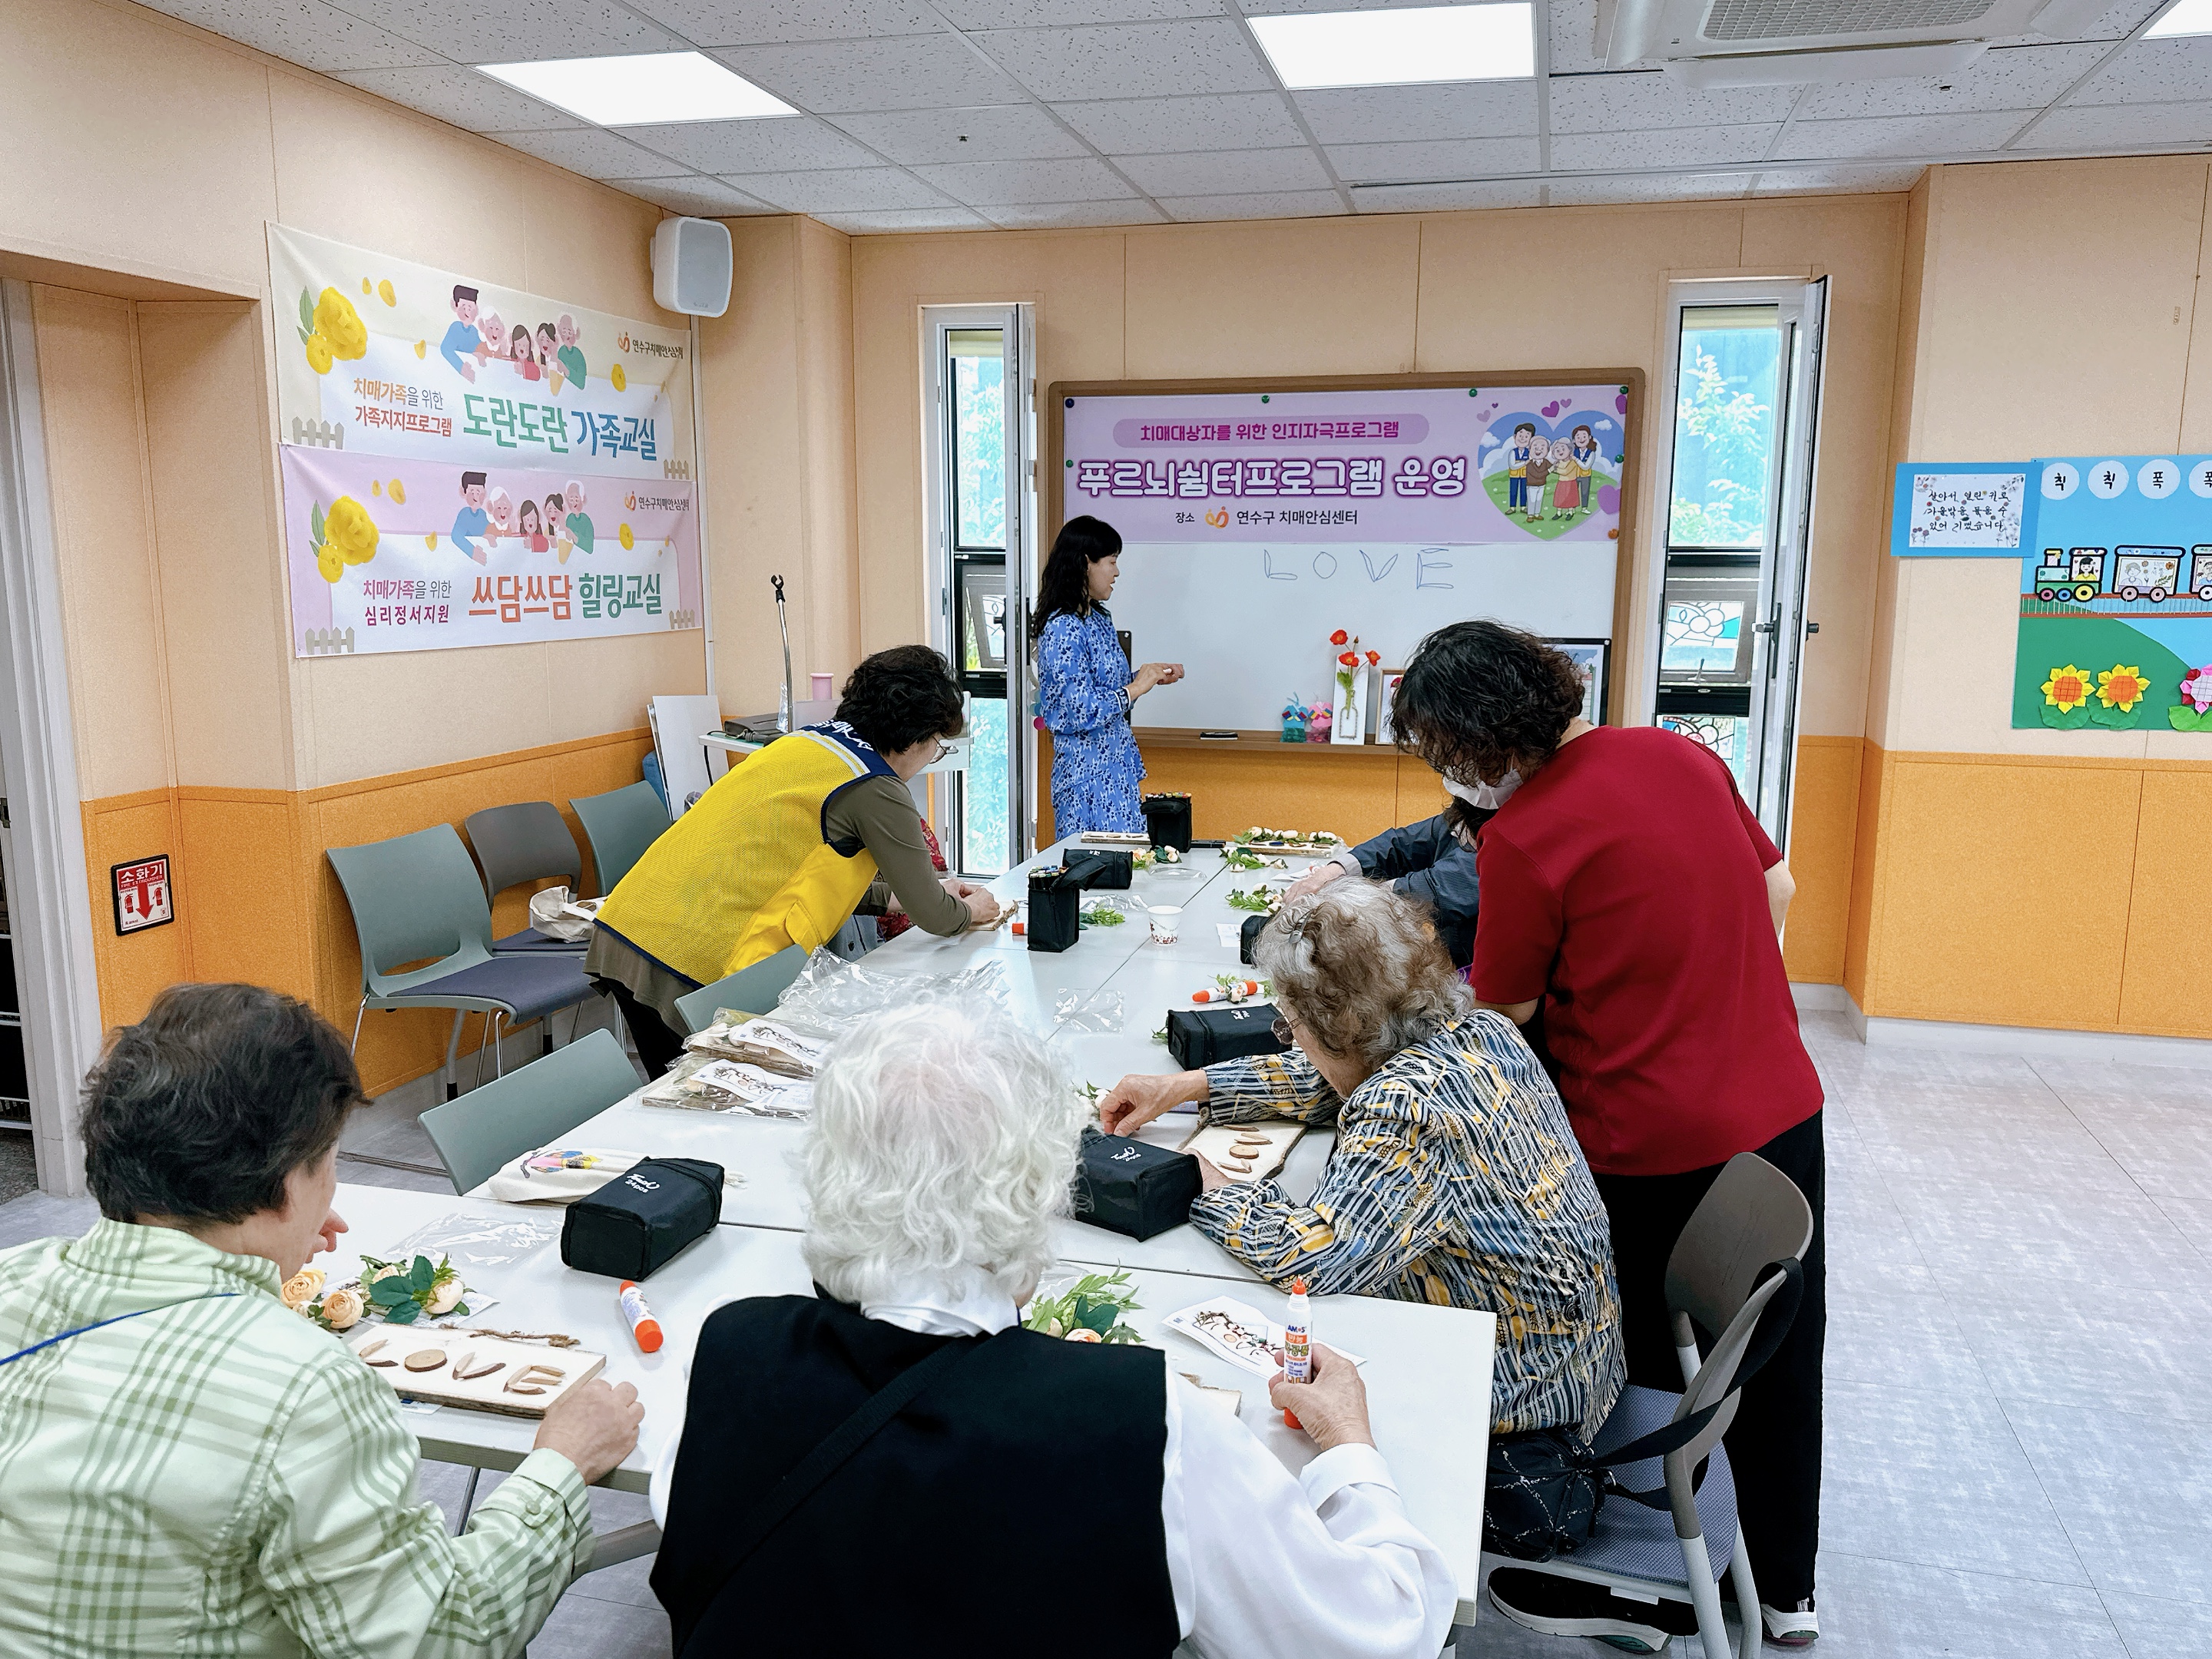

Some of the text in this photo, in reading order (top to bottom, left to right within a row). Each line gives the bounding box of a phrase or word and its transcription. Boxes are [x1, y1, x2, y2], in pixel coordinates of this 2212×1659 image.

[353, 377, 444, 411] 치매가족을 위한
[354, 405, 453, 439] 가족지지프로그램
[462, 392, 658, 462] 도란도란 가족교실
[1140, 420, 1400, 442] 치매대상자를 위한 인지자극프로그램
[1078, 457, 1468, 499] 푸르뇌쉼터프로그램 운영
[2055, 472, 2066, 492] 칙
[2103, 470, 2116, 490] 칙
[2152, 471, 2164, 489] 폭
[1175, 509, 1359, 526] 장소 연수구 치매안심센터
[1998, 505, 2008, 518] 수
[1263, 548, 1454, 591] LOVE
[363, 579, 452, 601] 치매가족을 위한
[469, 571, 663, 624] 쓰담쓰담 힐링교실
[364, 603, 450, 627] 심리정서지원
[121, 863, 163, 884] 소화기
